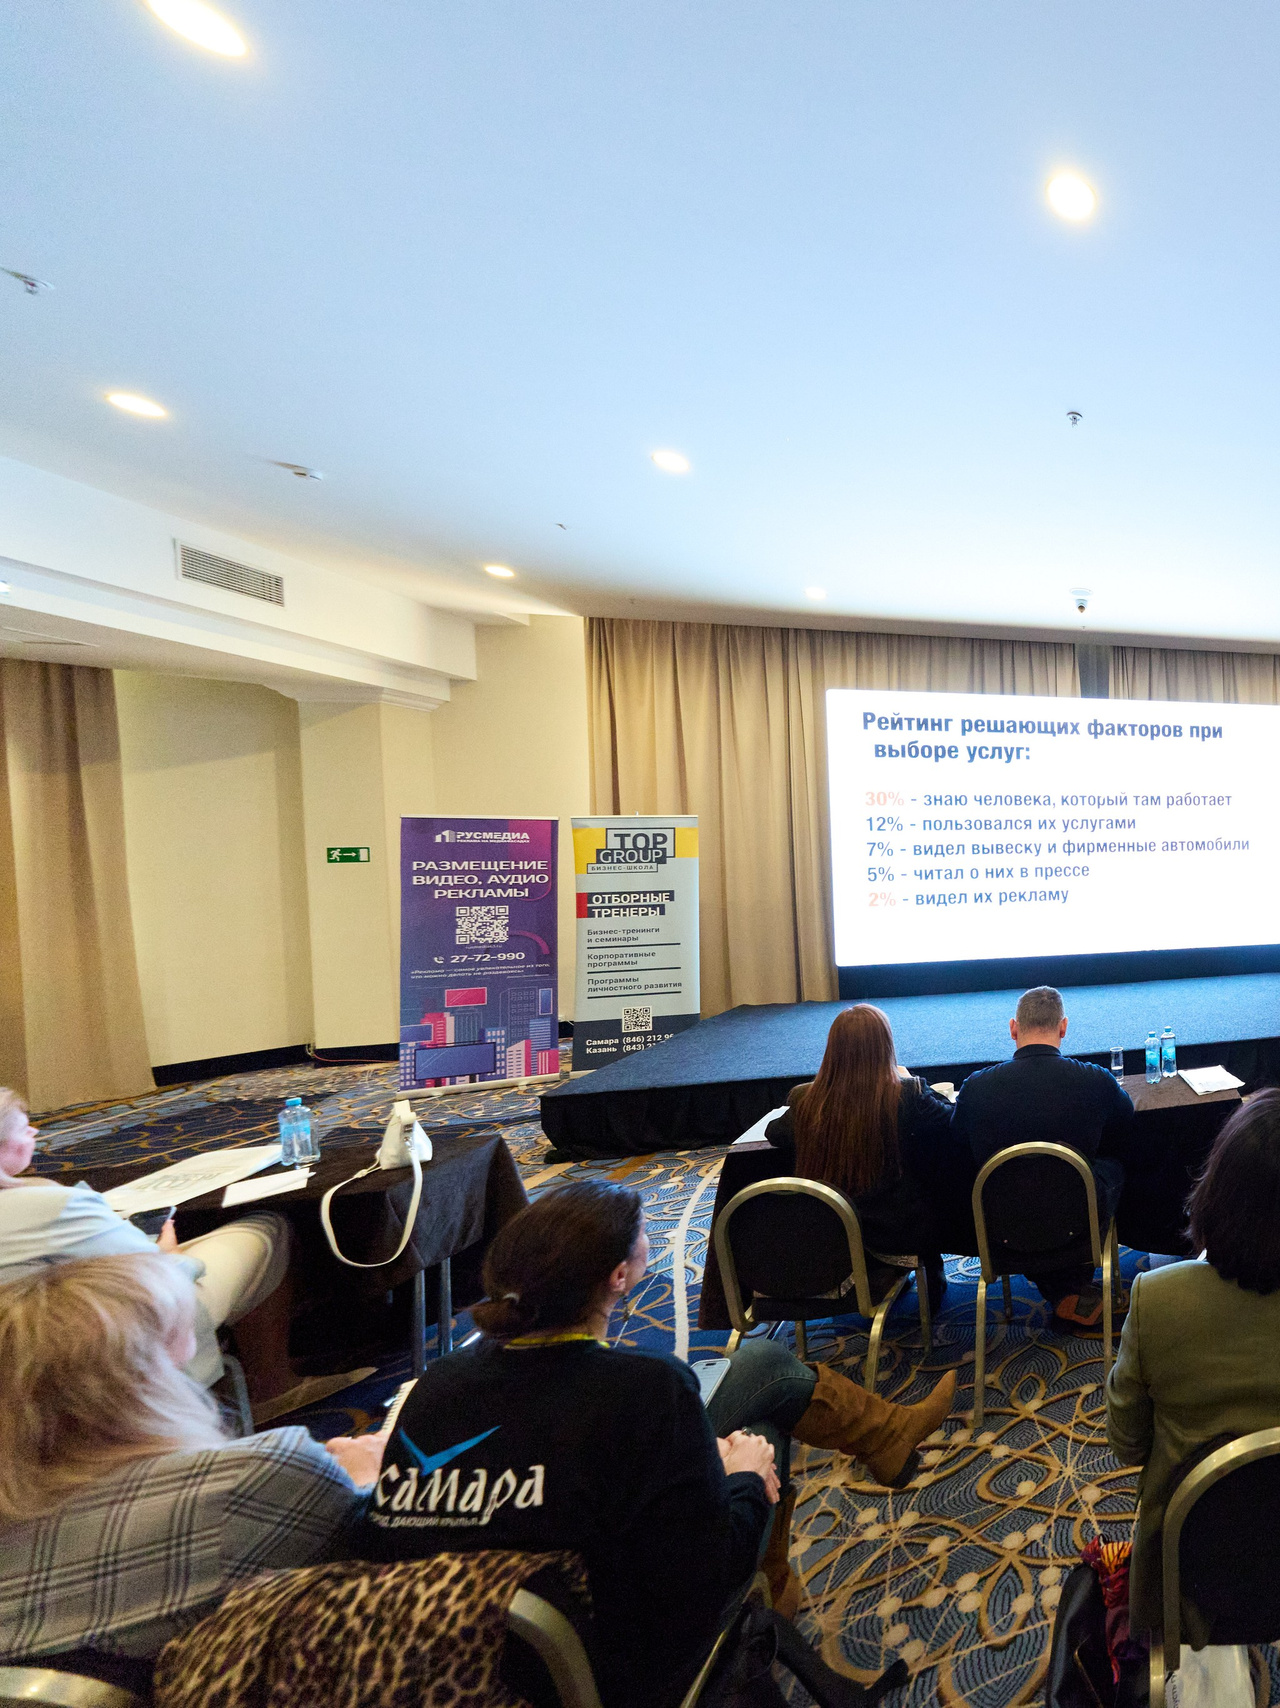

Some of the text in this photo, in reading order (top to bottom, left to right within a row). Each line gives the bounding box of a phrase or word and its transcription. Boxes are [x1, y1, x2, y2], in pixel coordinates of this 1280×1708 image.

[862, 711, 1223, 743] Рейтинг решающих факторов при
[874, 739, 1031, 764] выборе услуг:
[864, 791, 905, 807] 30%
[923, 794, 968, 807] знаю
[973, 794, 1056, 808] человека,
[1060, 791, 1128, 809] который
[1132, 795, 1161, 806] там
[1166, 791, 1232, 809] работает
[866, 816, 904, 832] 12%
[922, 818, 1033, 831] пользовался
[1038, 819, 1057, 830] их
[1061, 818, 1136, 833] услугами
[456, 831, 530, 840] РУСМЕДИА
[613, 832, 668, 848] TOP
[866, 841, 894, 857] 7%
[912, 843, 966, 858] видел
[971, 842, 1042, 857] вывеску
[1047, 842, 1057, 854] и
[1062, 839, 1157, 857] фирменные
[1161, 837, 1250, 852] автомобили
[599, 849, 663, 863] GROUP
[412, 860, 549, 872] РАЗМЕЩЕНИЕ
[867, 866, 895, 882] 5%
[913, 868, 964, 881] читал
[969, 867, 980, 880] о
[985, 867, 1014, 879] них
[1019, 867, 1029, 878] в
[1034, 865, 1090, 881] прессе
[412, 874, 549, 886] ВИДЕО, АУДИО
[434, 888, 529, 899] РЕКЛАМЫ
[592, 892, 671, 905] ОТБОРНЫЕ
[868, 891, 897, 908] 2%
[915, 892, 968, 908] видел
[973, 892, 993, 904] их
[998, 889, 1069, 907] рекламу
[592, 907, 660, 918] ТРЕНЕРЫ
[587, 927, 660, 936] Бизнес-тренинги
[594, 935, 639, 943] семинары
[450, 952, 526, 963] 27-72-990
[587, 951, 657, 960] Корпоративные
[587, 960, 638, 968] программы
[587, 977, 640, 986] Программы
[587, 981, 683, 993] личностного развития
[586, 1038, 619, 1046] Самара
[622, 1035, 645, 1044] (846)
[646, 1034, 662, 1042] 212
[586, 1046, 617, 1054] Казань
[622, 1043, 645, 1053] (843)
